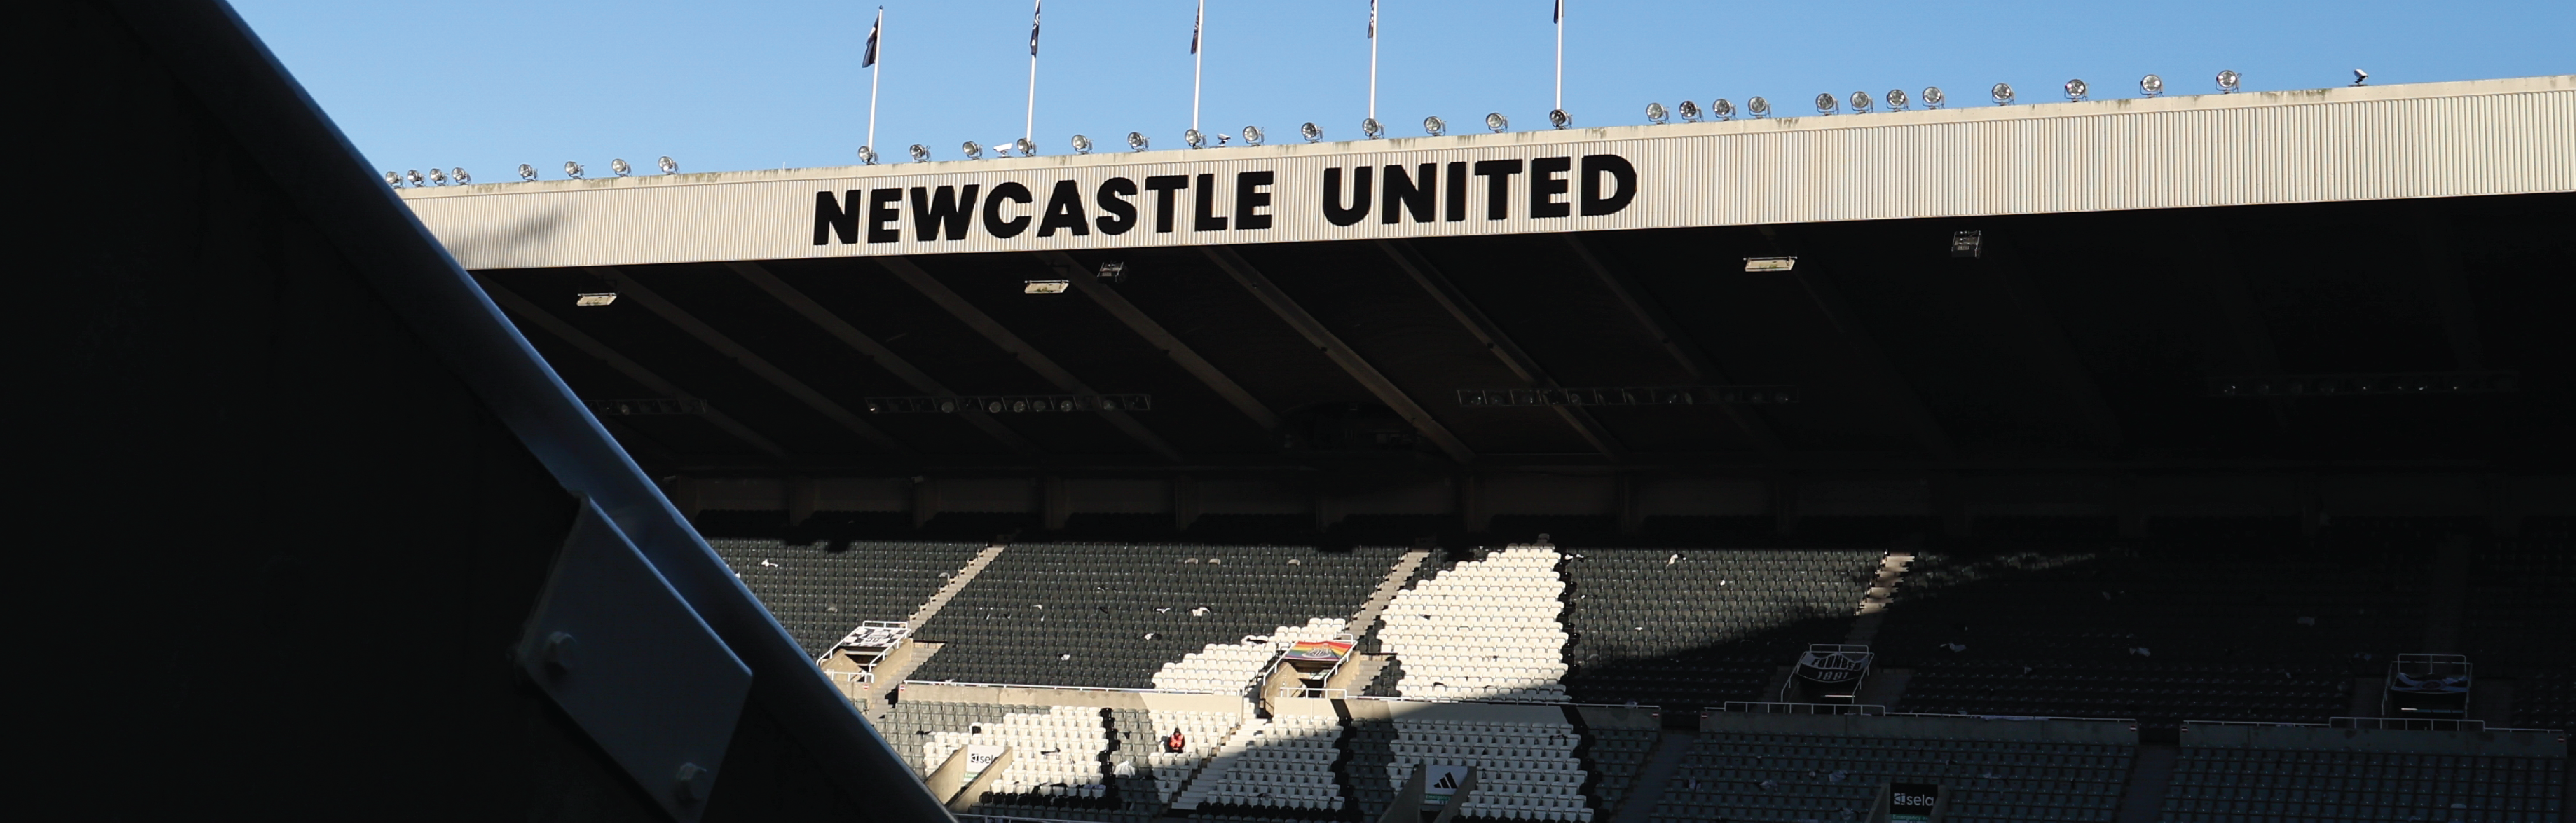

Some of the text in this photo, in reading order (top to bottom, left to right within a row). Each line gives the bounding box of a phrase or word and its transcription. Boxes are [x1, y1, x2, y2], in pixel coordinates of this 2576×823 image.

[813, 154, 1638, 246] NEWCASTLE UNITED
[1811, 655, 1861, 670] FOUNDED
[1817, 671, 1849, 680] 1881
[1906, 793, 1935, 807] sela
